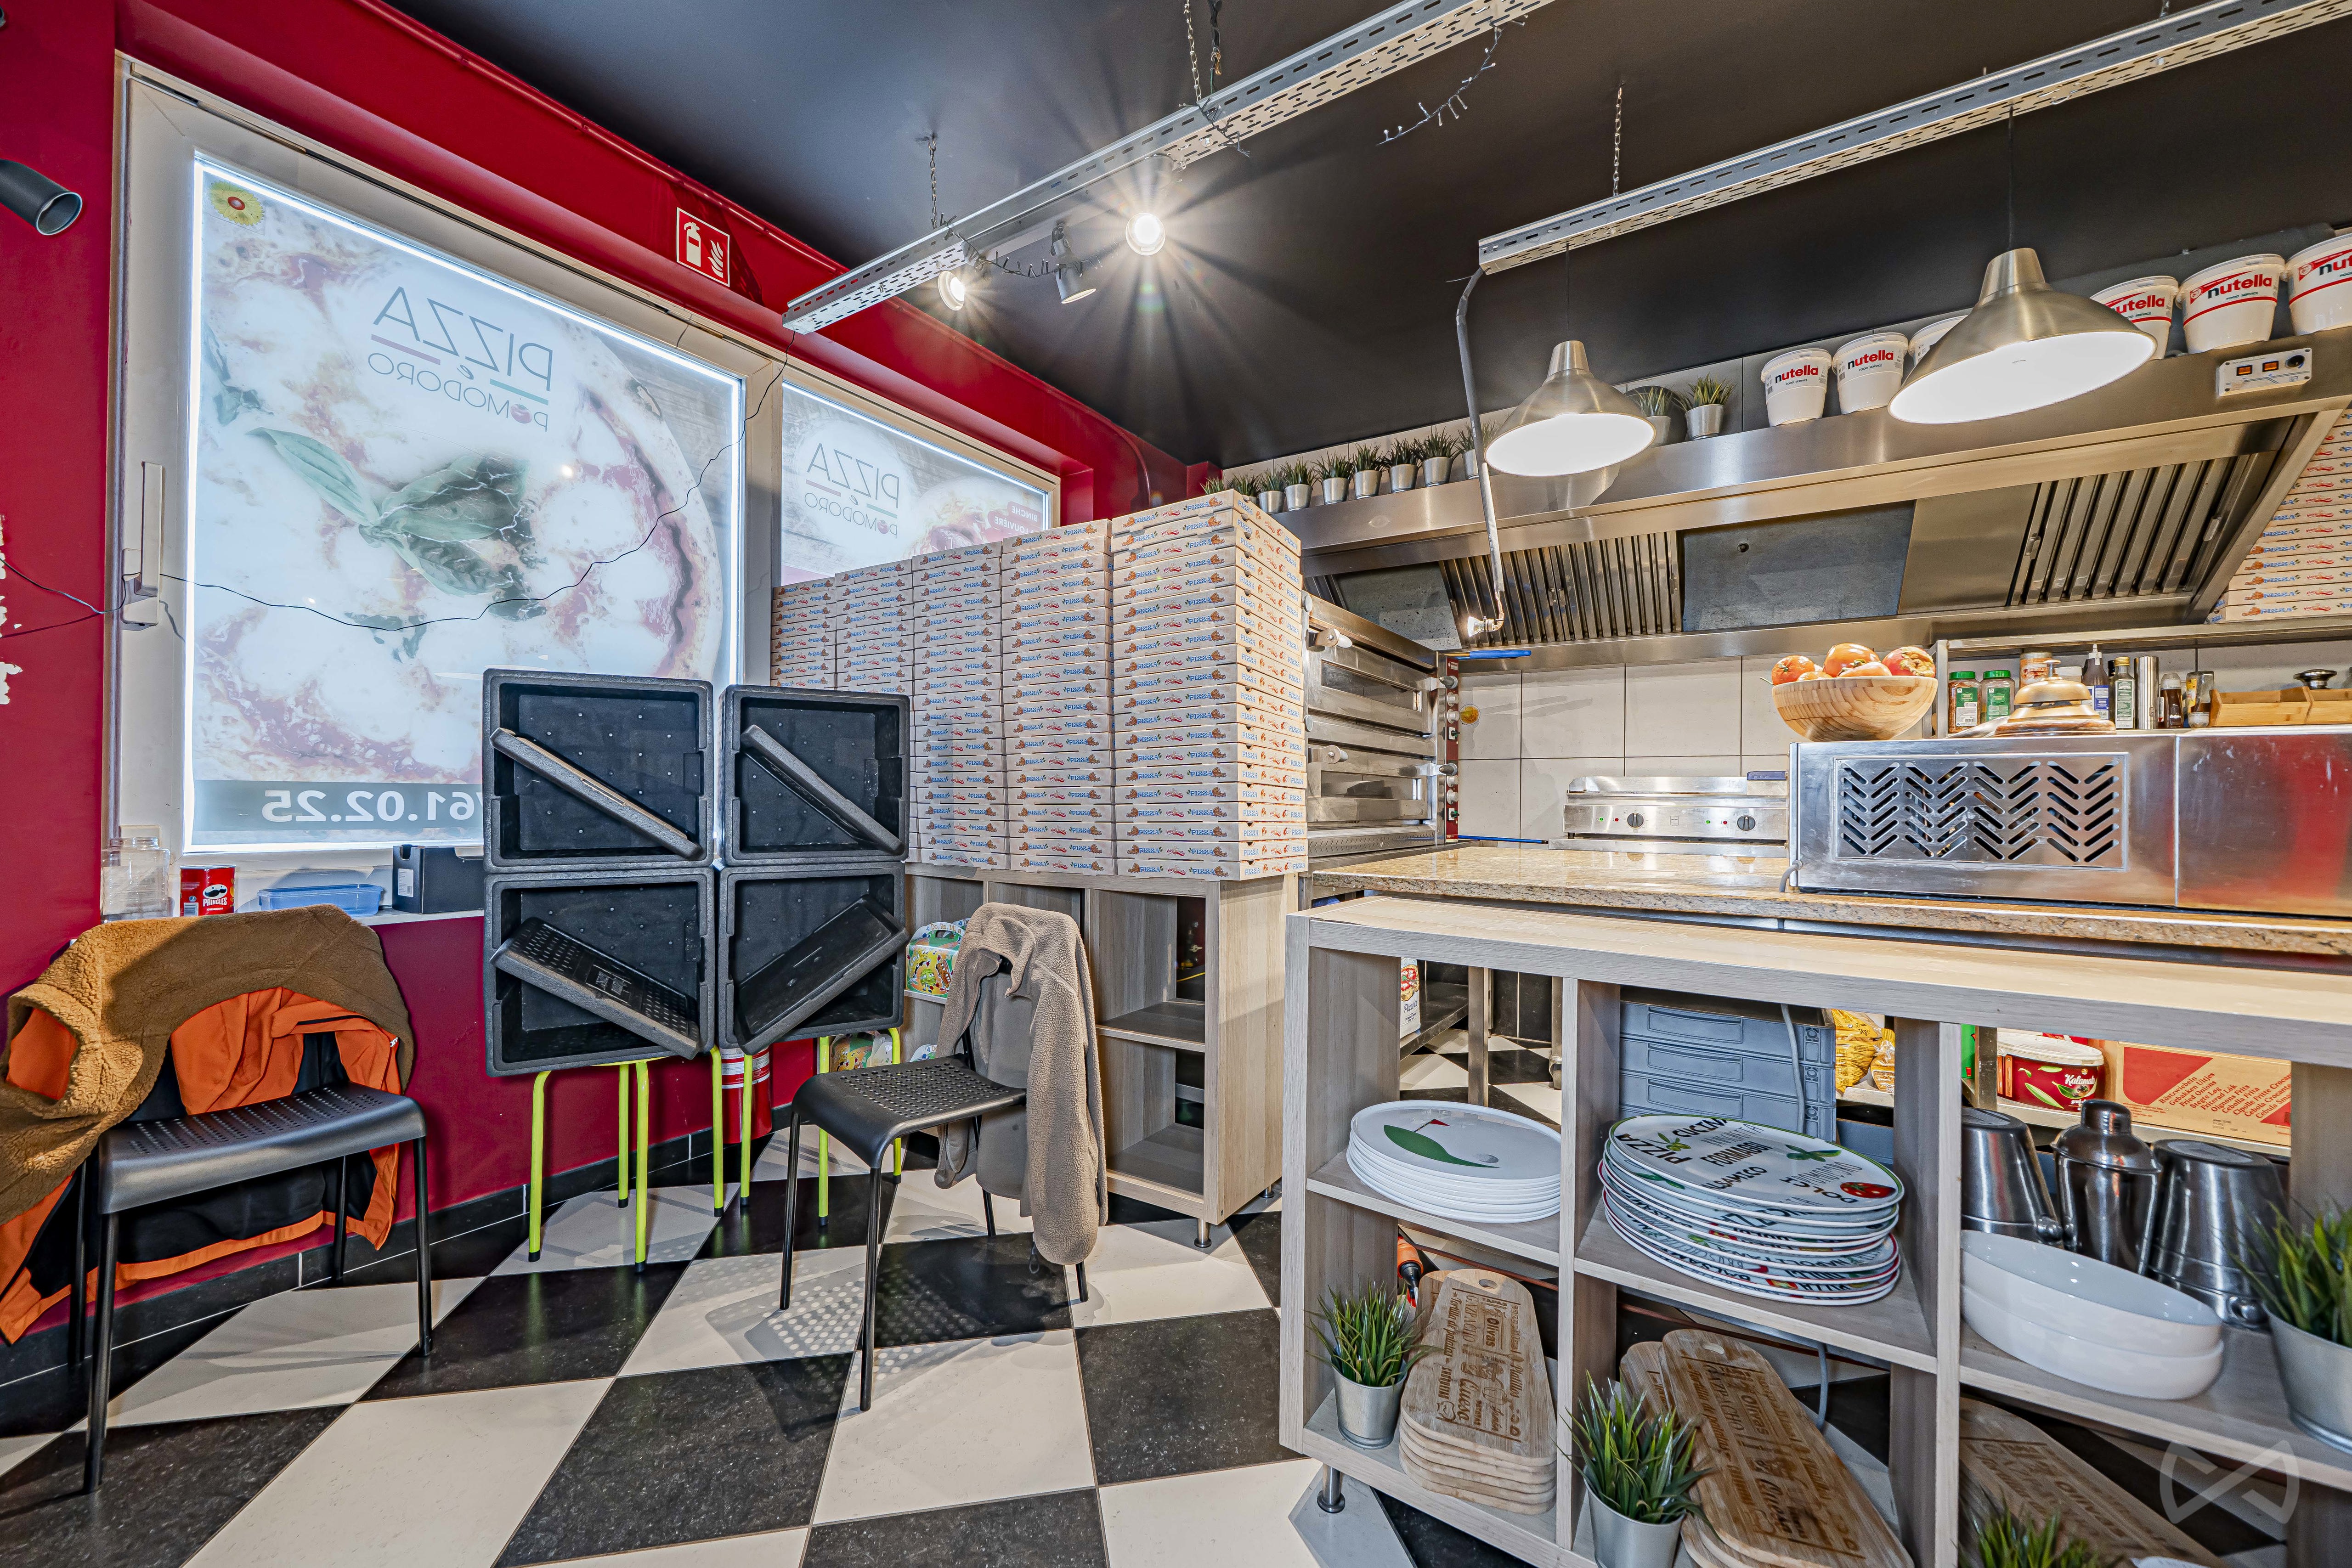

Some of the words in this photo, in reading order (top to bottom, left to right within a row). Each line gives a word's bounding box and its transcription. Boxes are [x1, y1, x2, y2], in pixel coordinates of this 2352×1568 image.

[2208, 274, 2272, 299] nutella
[2112, 295, 2165, 314] utella
[1848, 350, 1894, 370] nutella
[1775, 365, 1818, 384] nutella
[1135, 514, 1155, 524] PIZZA
[1187, 501, 1210, 511] PIZZA
[1238, 500, 1254, 515] PIZZA
[1134, 534, 1154, 542] PIZZA
[1186, 521, 1209, 530] PIZZA
[1136, 551, 1158, 559] PIZZA
[1188, 538, 1211, 548] PIZZA
[927, 554, 945, 563] PIZZA
[2264, 561, 2296, 569] PIZZA
[1136, 570, 1157, 579] PIZZA
[1188, 558, 1211, 568] PIZZA
[1136, 587, 1157, 596] PIZZA
[1188, 576, 1212, 587] PIZZA
[1240, 576, 1255, 590] PIZZA
[2264, 592, 2296, 600] PIZZA
[930, 618, 948, 626] PIZZA
[1136, 624, 1157, 632] PIZZA
[1188, 615, 1211, 625] PIZZA
[1064, 632, 1085, 640] PIZZA
[1136, 642, 1158, 651] PIZZA
[1188, 634, 1212, 643] PIZZA
[1136, 661, 1158, 670] PIZZA
[1189, 654, 1213, 663] PIZZA
[1241, 654, 1257, 665] PIZZA
[1136, 679, 1159, 688] PIZZA
[1189, 671, 1213, 682] PIZZA
[1065, 703, 1087, 711] PIZZA
[1136, 698, 1158, 706] PIZZA
[1188, 692, 1212, 701] PIZZA
[1136, 716, 1159, 725] PIZZA
[1188, 711, 1212, 720] PIZZA
[1137, 734, 1159, 743] PIZZA
[1189, 731, 1214, 739] PIZZA
[1242, 732, 1258, 741] PIZZA
[1137, 754, 1160, 762] PIZZA
[1190, 750, 1213, 759] PIZZA
[1243, 809, 1260, 818] PIZZA
[203, 897, 227, 907] PRINGLES
[2159, 1076, 2197, 1104] Röstzwiebeln
[2169, 1085, 2198, 1105] Gebakken
[2196, 1072, 2215, 1086] Uitjes
[2179, 1094, 2196, 1107] Fried
[2196, 1080, 2216, 1095] Onions
[2190, 1095, 2210, 1109] Stegte
[2208, 1086, 2222, 1096] Løg
[2200, 1093, 2225, 1110] Friterad
[2211, 1094, 2236, 1112] Oignons
[2234, 1084, 2250, 1096] Frits
[2222, 1097, 2245, 1113] Cebolla
[2244, 1087, 2260, 1099] Frita
[2233, 1100, 2255, 1115] Cipolle
[2253, 1089, 2272, 1101] Fritte
[2244, 1102, 2266, 1117] Cebola
[2256, 1104, 2278, 1118] Cebula
[1614, 1134, 1694, 1164] PIZZA
[1699, 1141, 1773, 1167] FORMAGGI
[1702, 1167, 1768, 1190] ALSAMICO
[1486, 1318, 1500, 1348] Olivas
[1457, 1378, 1479, 1421] Queso
